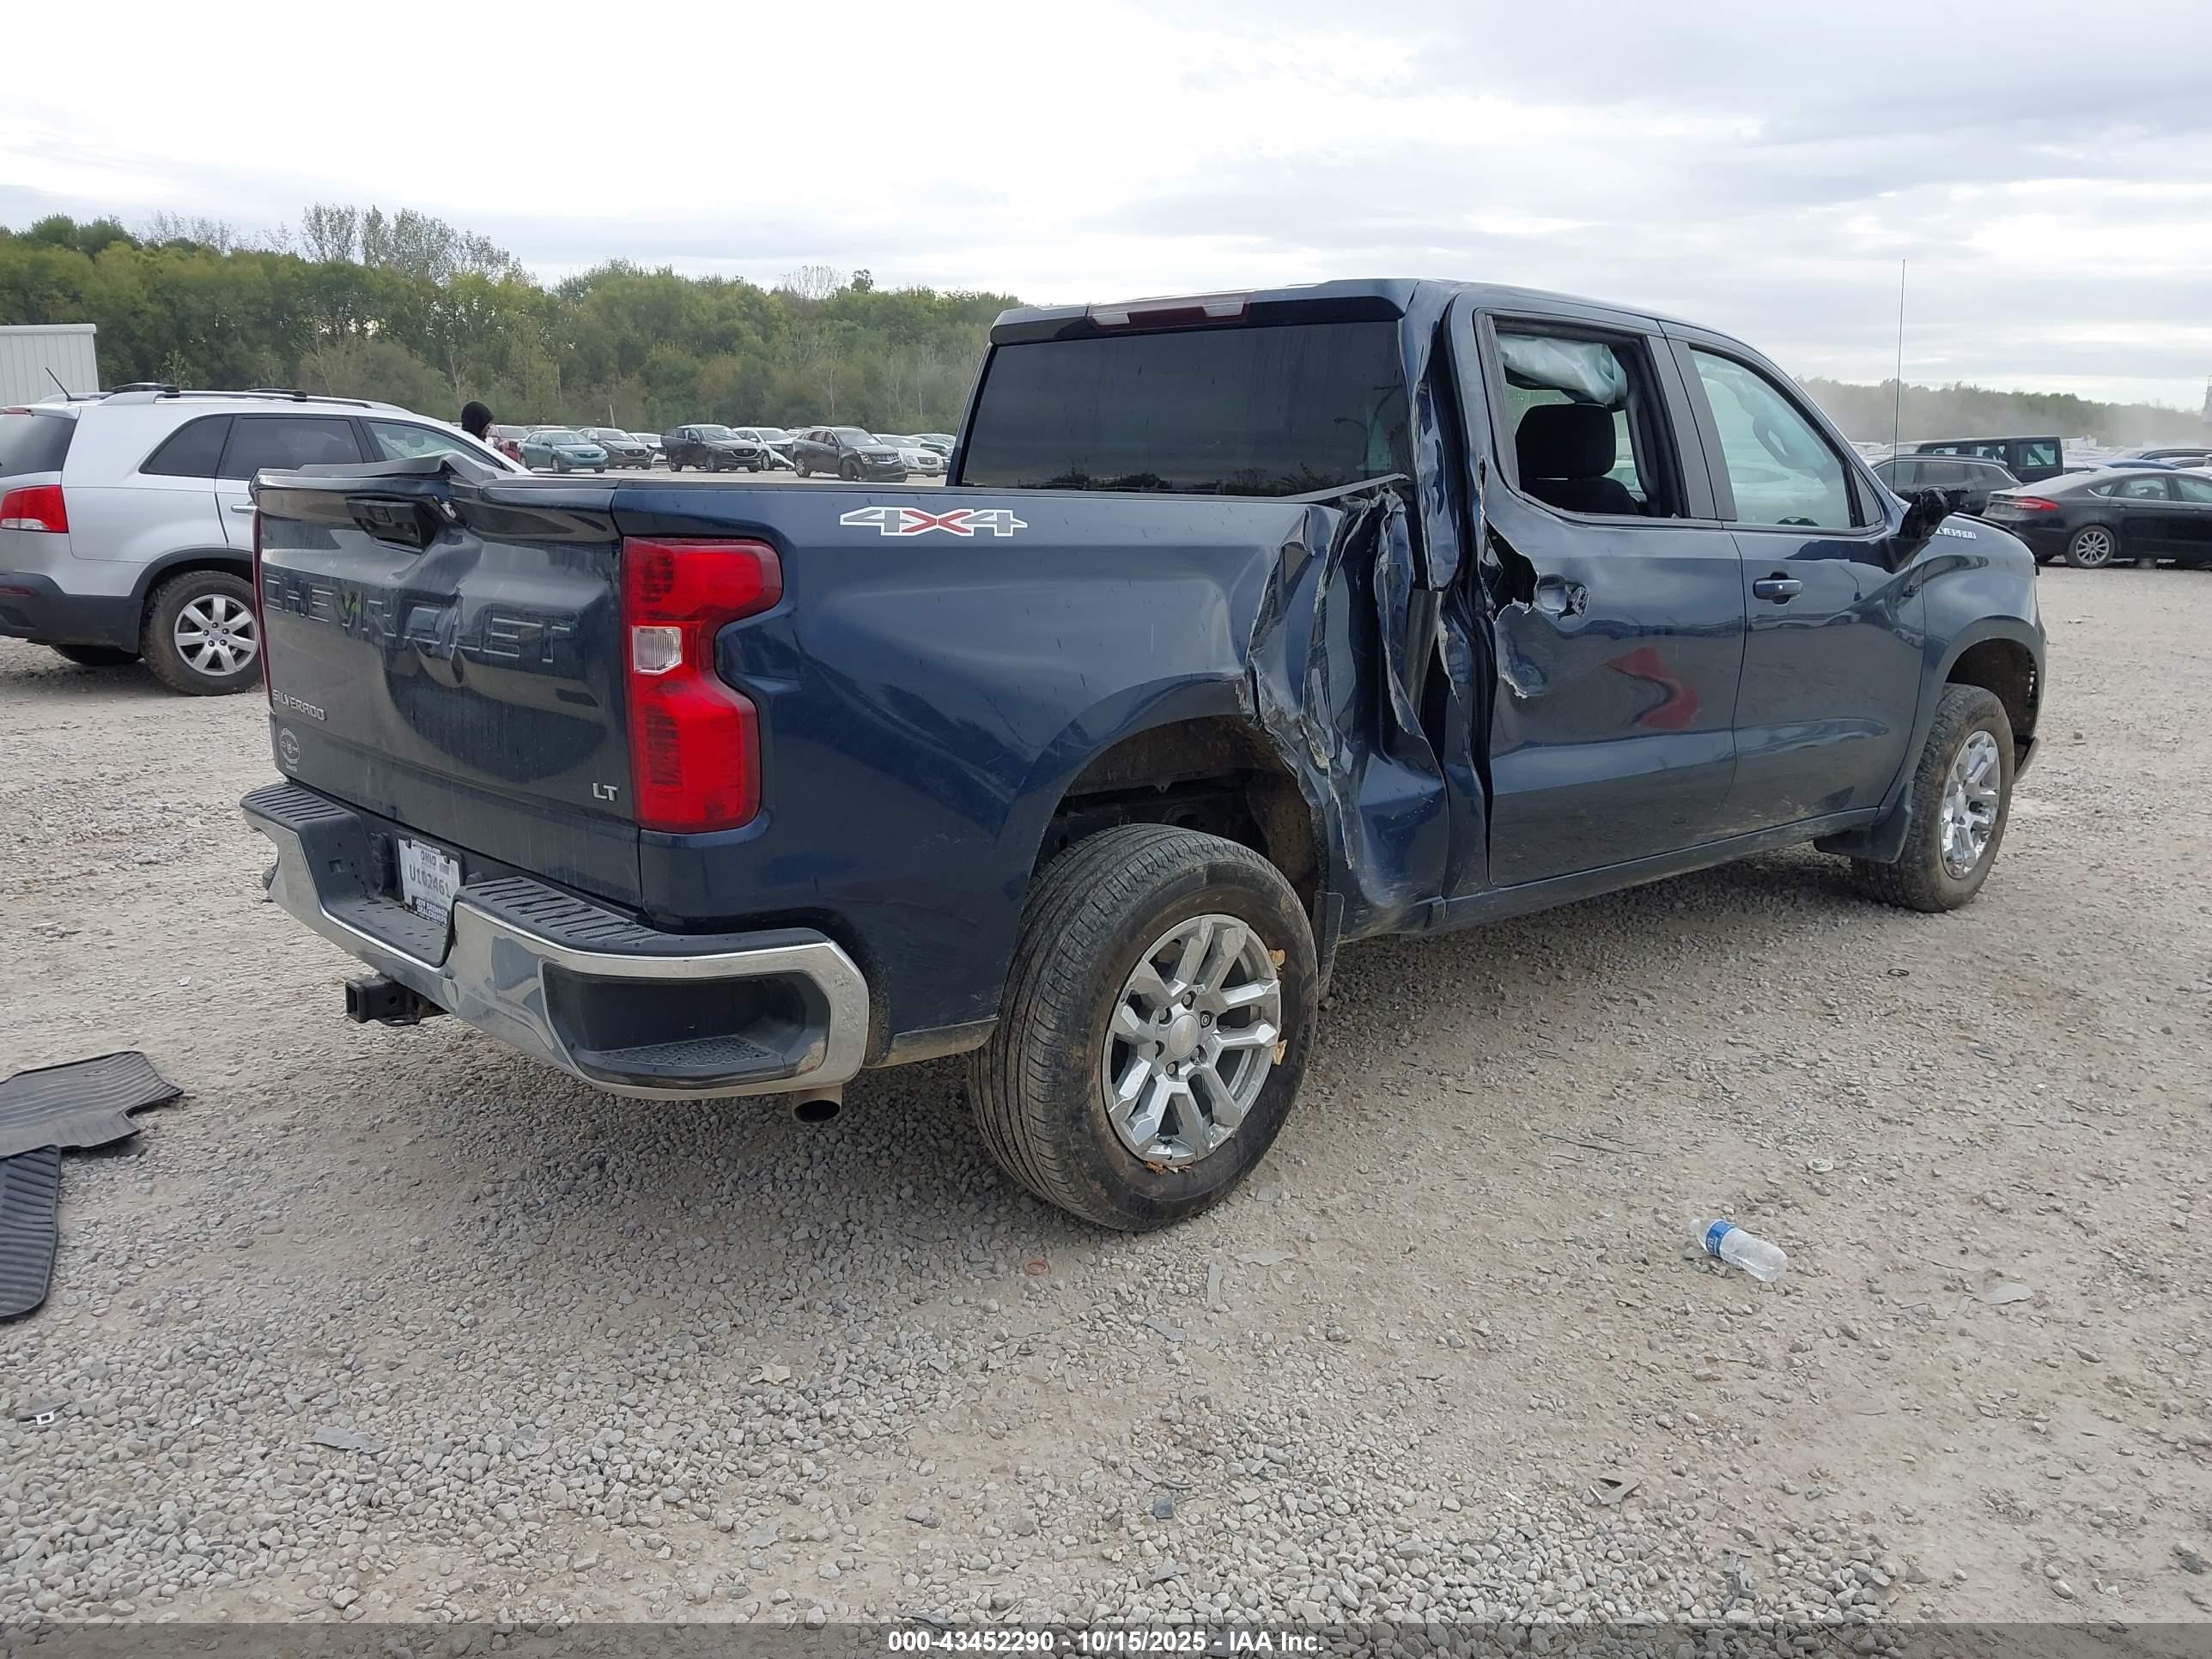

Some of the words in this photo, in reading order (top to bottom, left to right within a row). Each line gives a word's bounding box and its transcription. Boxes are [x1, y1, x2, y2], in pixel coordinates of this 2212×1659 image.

[272, 689, 326, 721] SILVERADO
[592, 782, 618, 801] LT
[420, 850, 437, 866] OHIO
